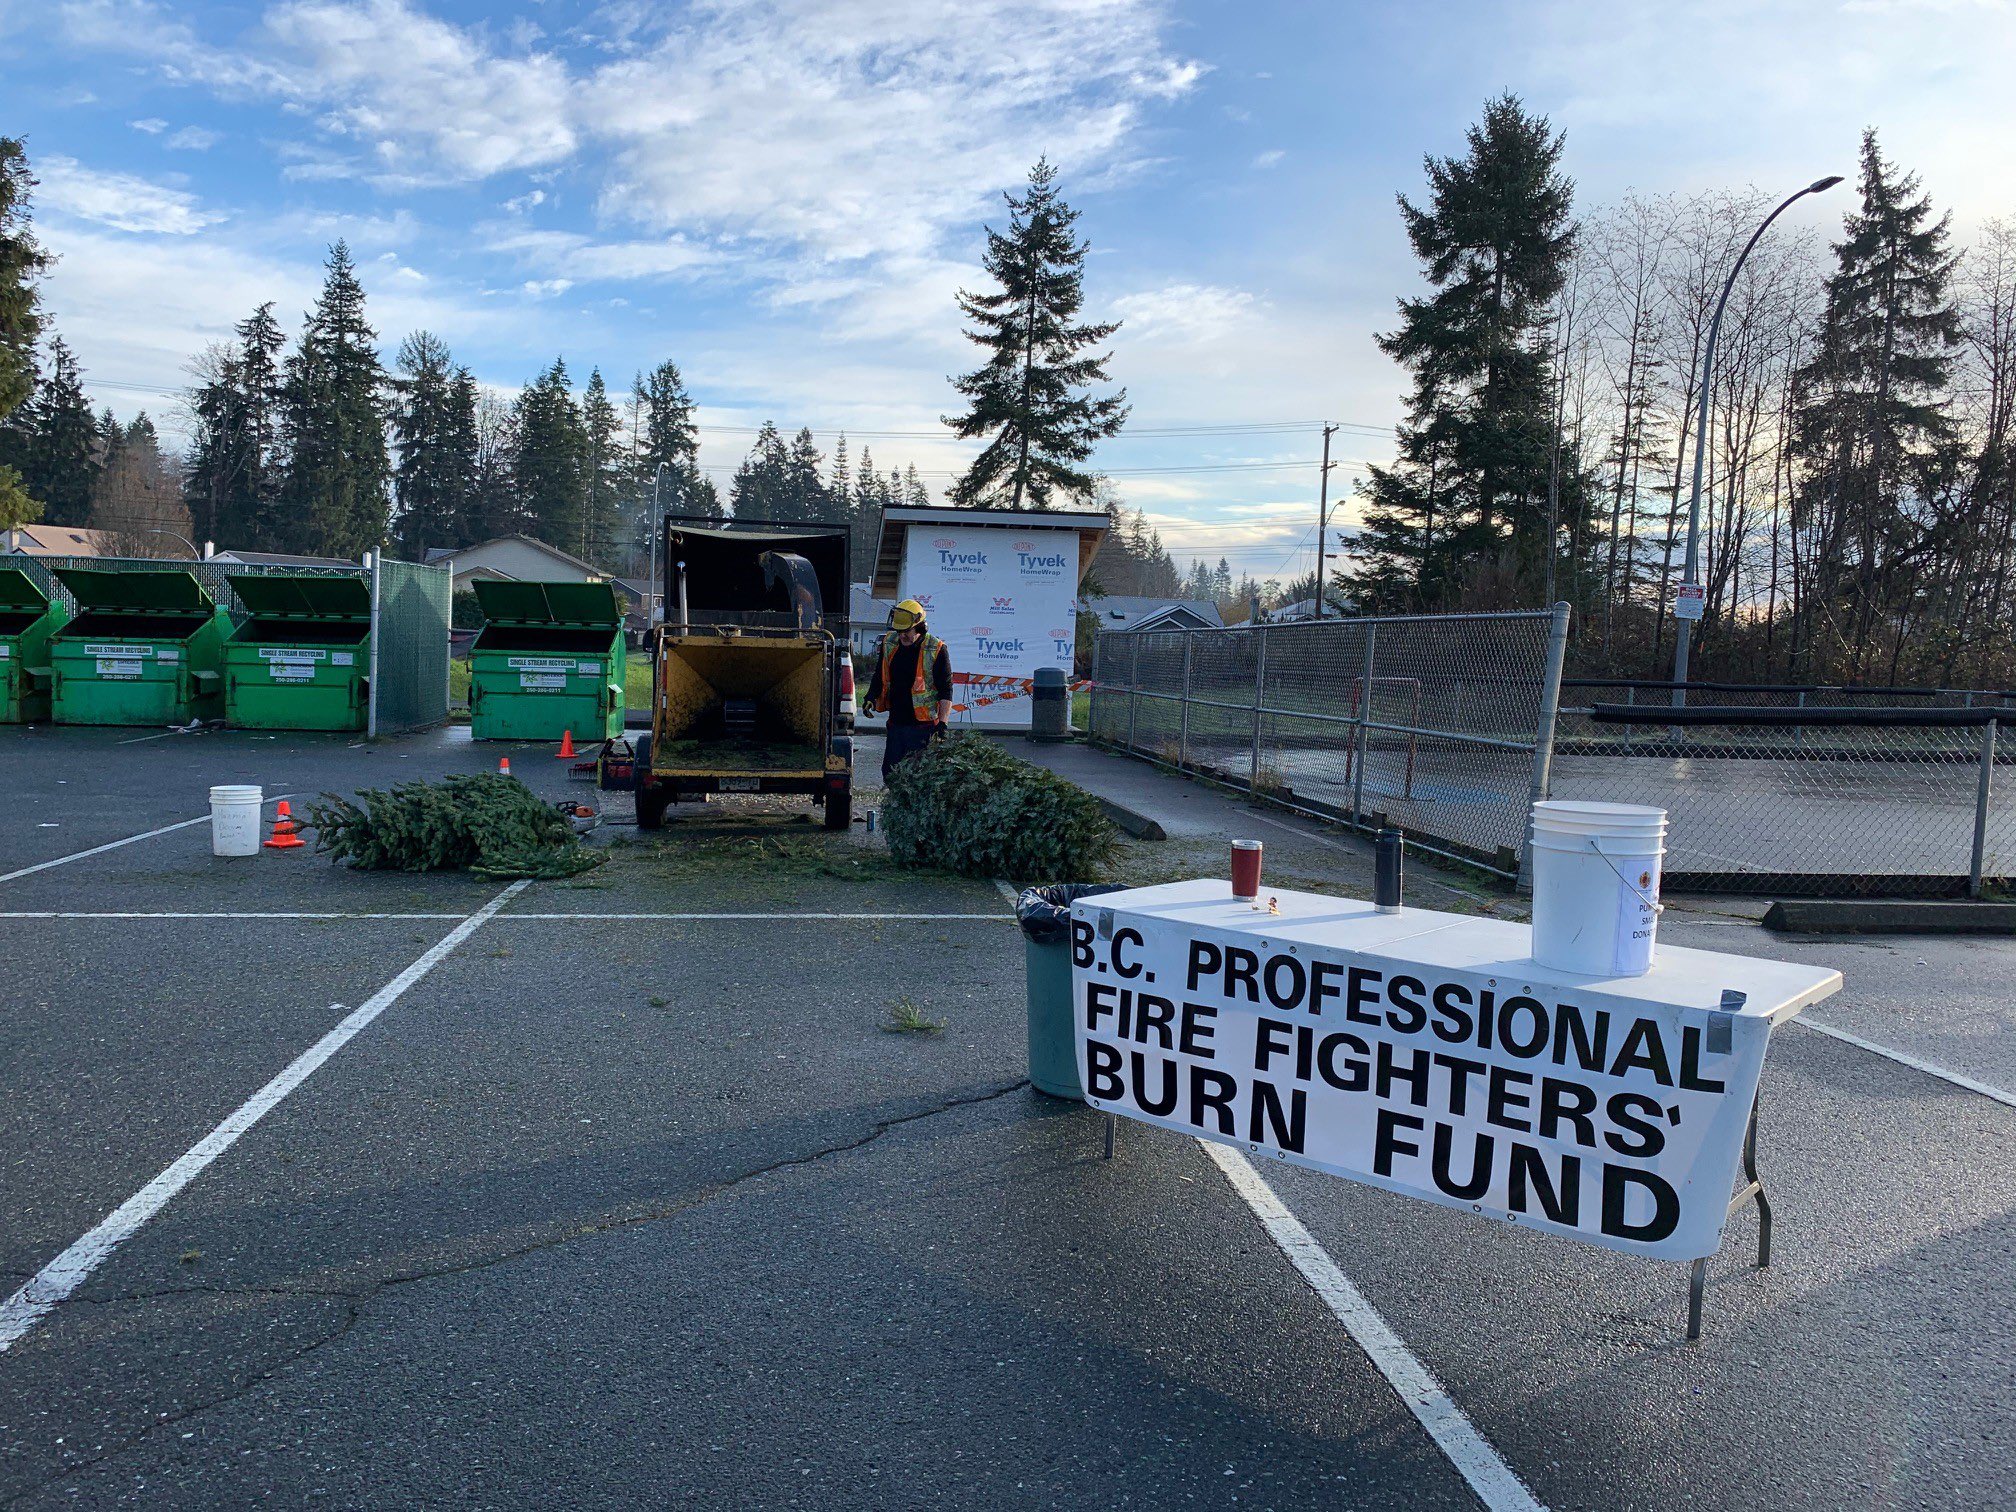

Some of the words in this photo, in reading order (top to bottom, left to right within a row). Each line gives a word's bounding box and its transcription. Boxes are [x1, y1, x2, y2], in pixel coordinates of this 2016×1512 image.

[938, 550, 987, 566] Tyvek
[1018, 553, 1066, 569] Tyvek
[976, 637, 1024, 653] Tyvek
[1071, 919, 1155, 983] B.C.
[1187, 939, 1725, 1093] PROFESSIONAL
[1087, 981, 1218, 1059] FIRE
[1254, 1016, 1681, 1158] FIGHTERS'
[1087, 1037, 1307, 1155] BURN
[1373, 1108, 1680, 1243] FUND
